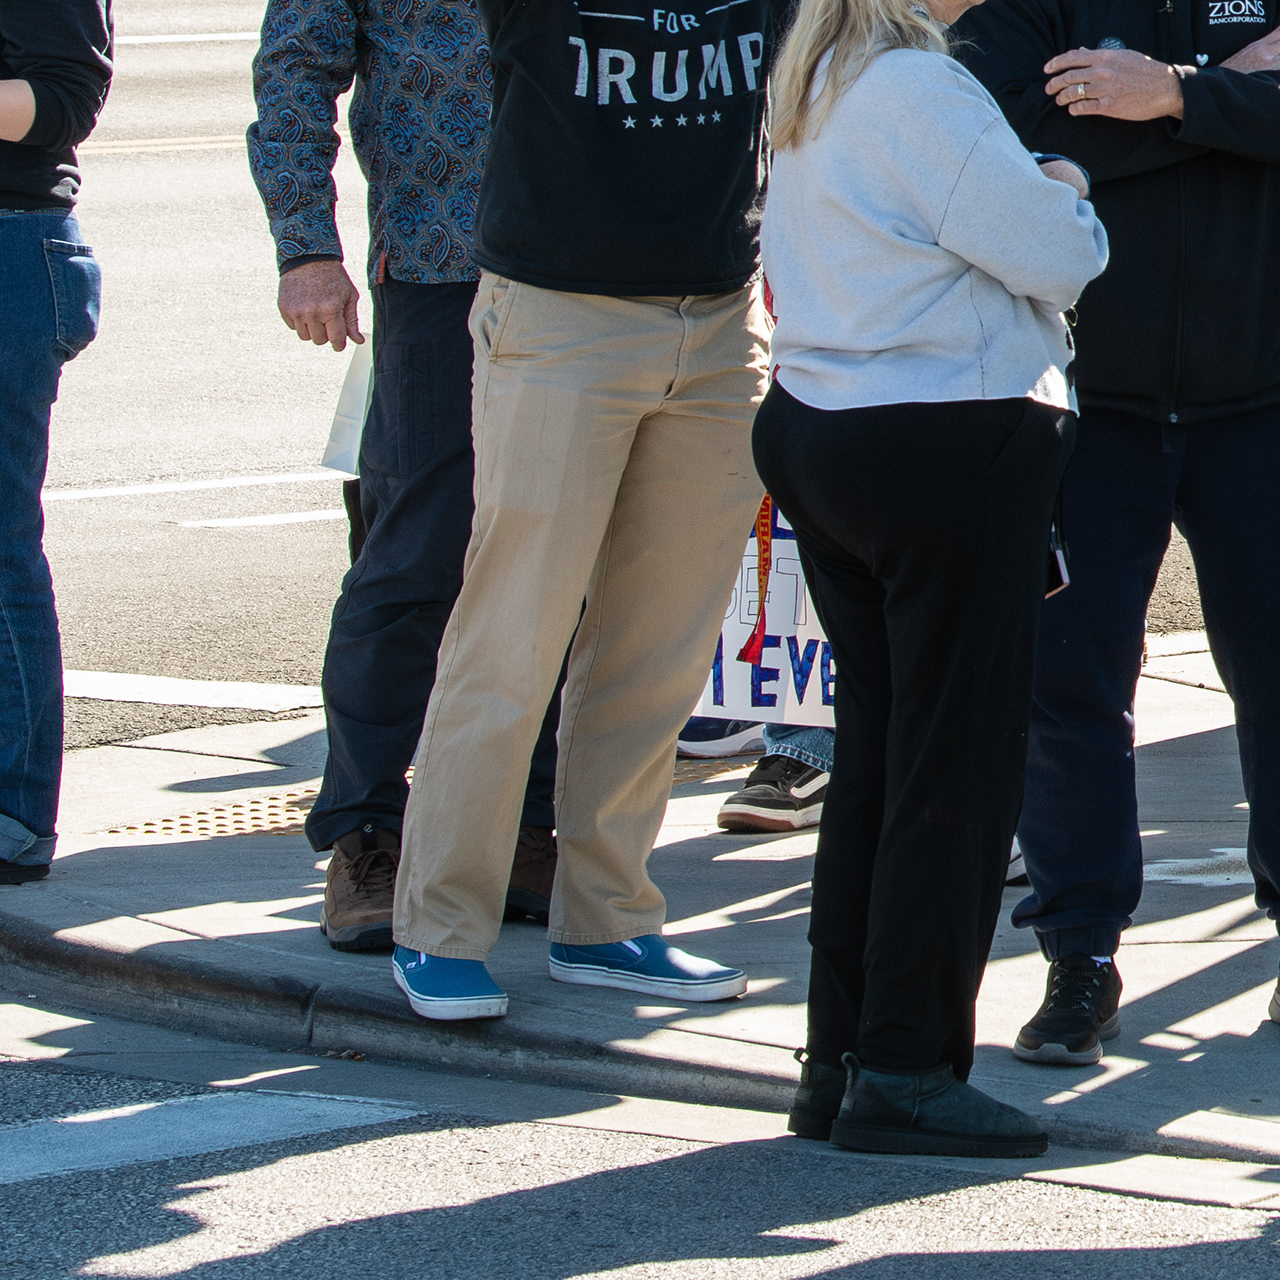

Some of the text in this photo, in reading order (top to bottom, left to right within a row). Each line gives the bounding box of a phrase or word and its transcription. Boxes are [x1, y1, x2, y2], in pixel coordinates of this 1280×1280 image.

[1209, 0, 1265, 17] ZIONS
[653, 9, 700, 33] FOR
[1209, 16, 1266, 25] BANCORPORATION
[568, 32, 763, 105] TRUMP
